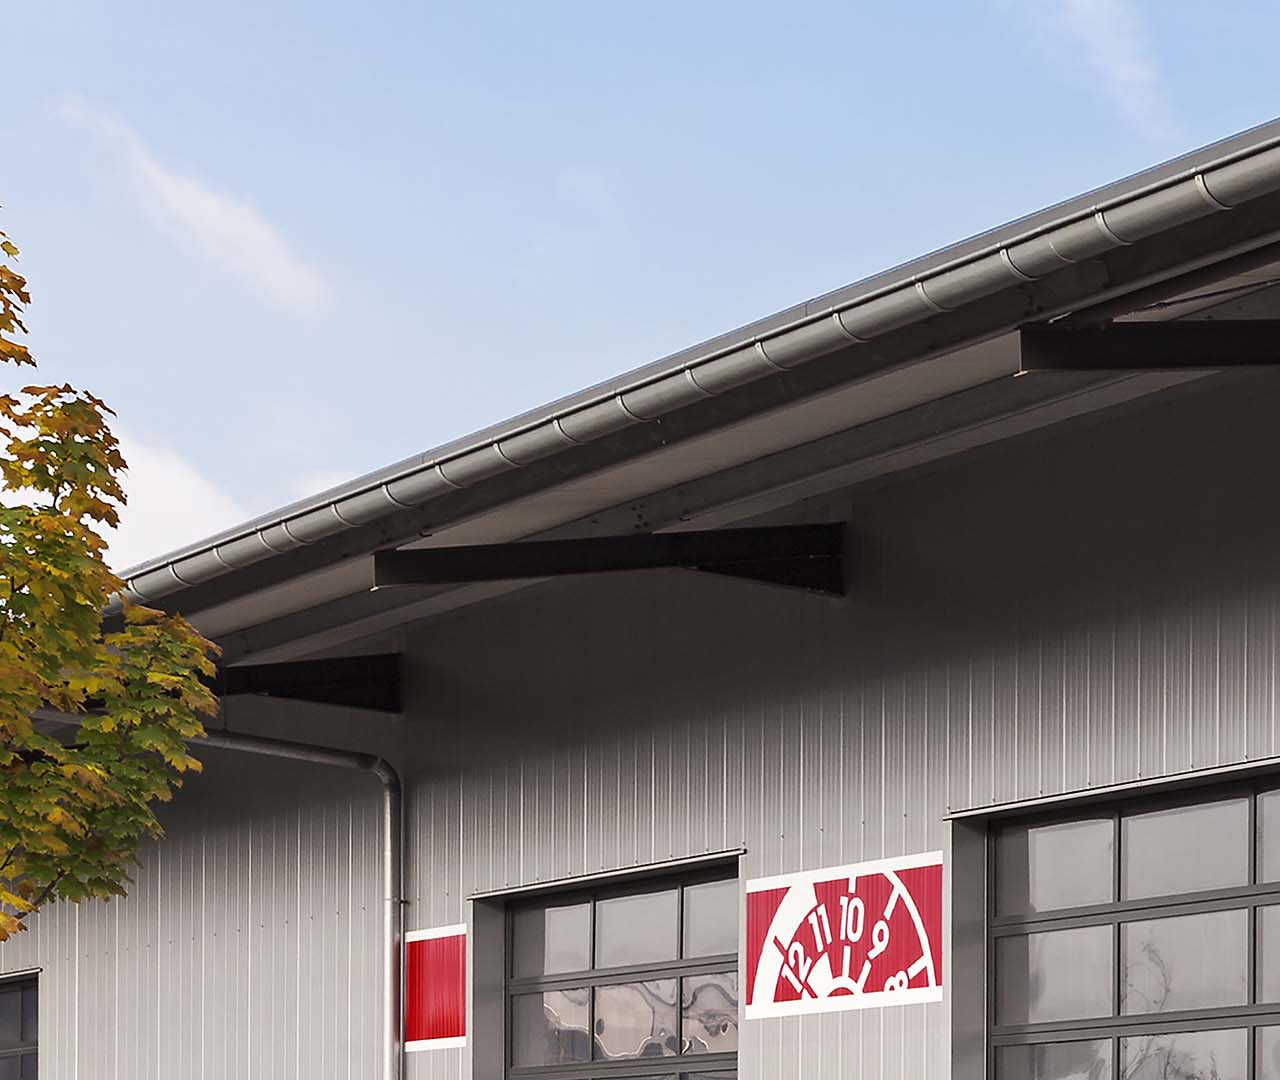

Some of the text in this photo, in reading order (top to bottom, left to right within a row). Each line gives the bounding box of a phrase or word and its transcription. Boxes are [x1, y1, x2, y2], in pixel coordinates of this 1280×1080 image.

[808, 903, 832, 953] 11
[839, 896, 865, 942] 10
[867, 919, 890, 960] 9
[781, 941, 812, 993] 12
